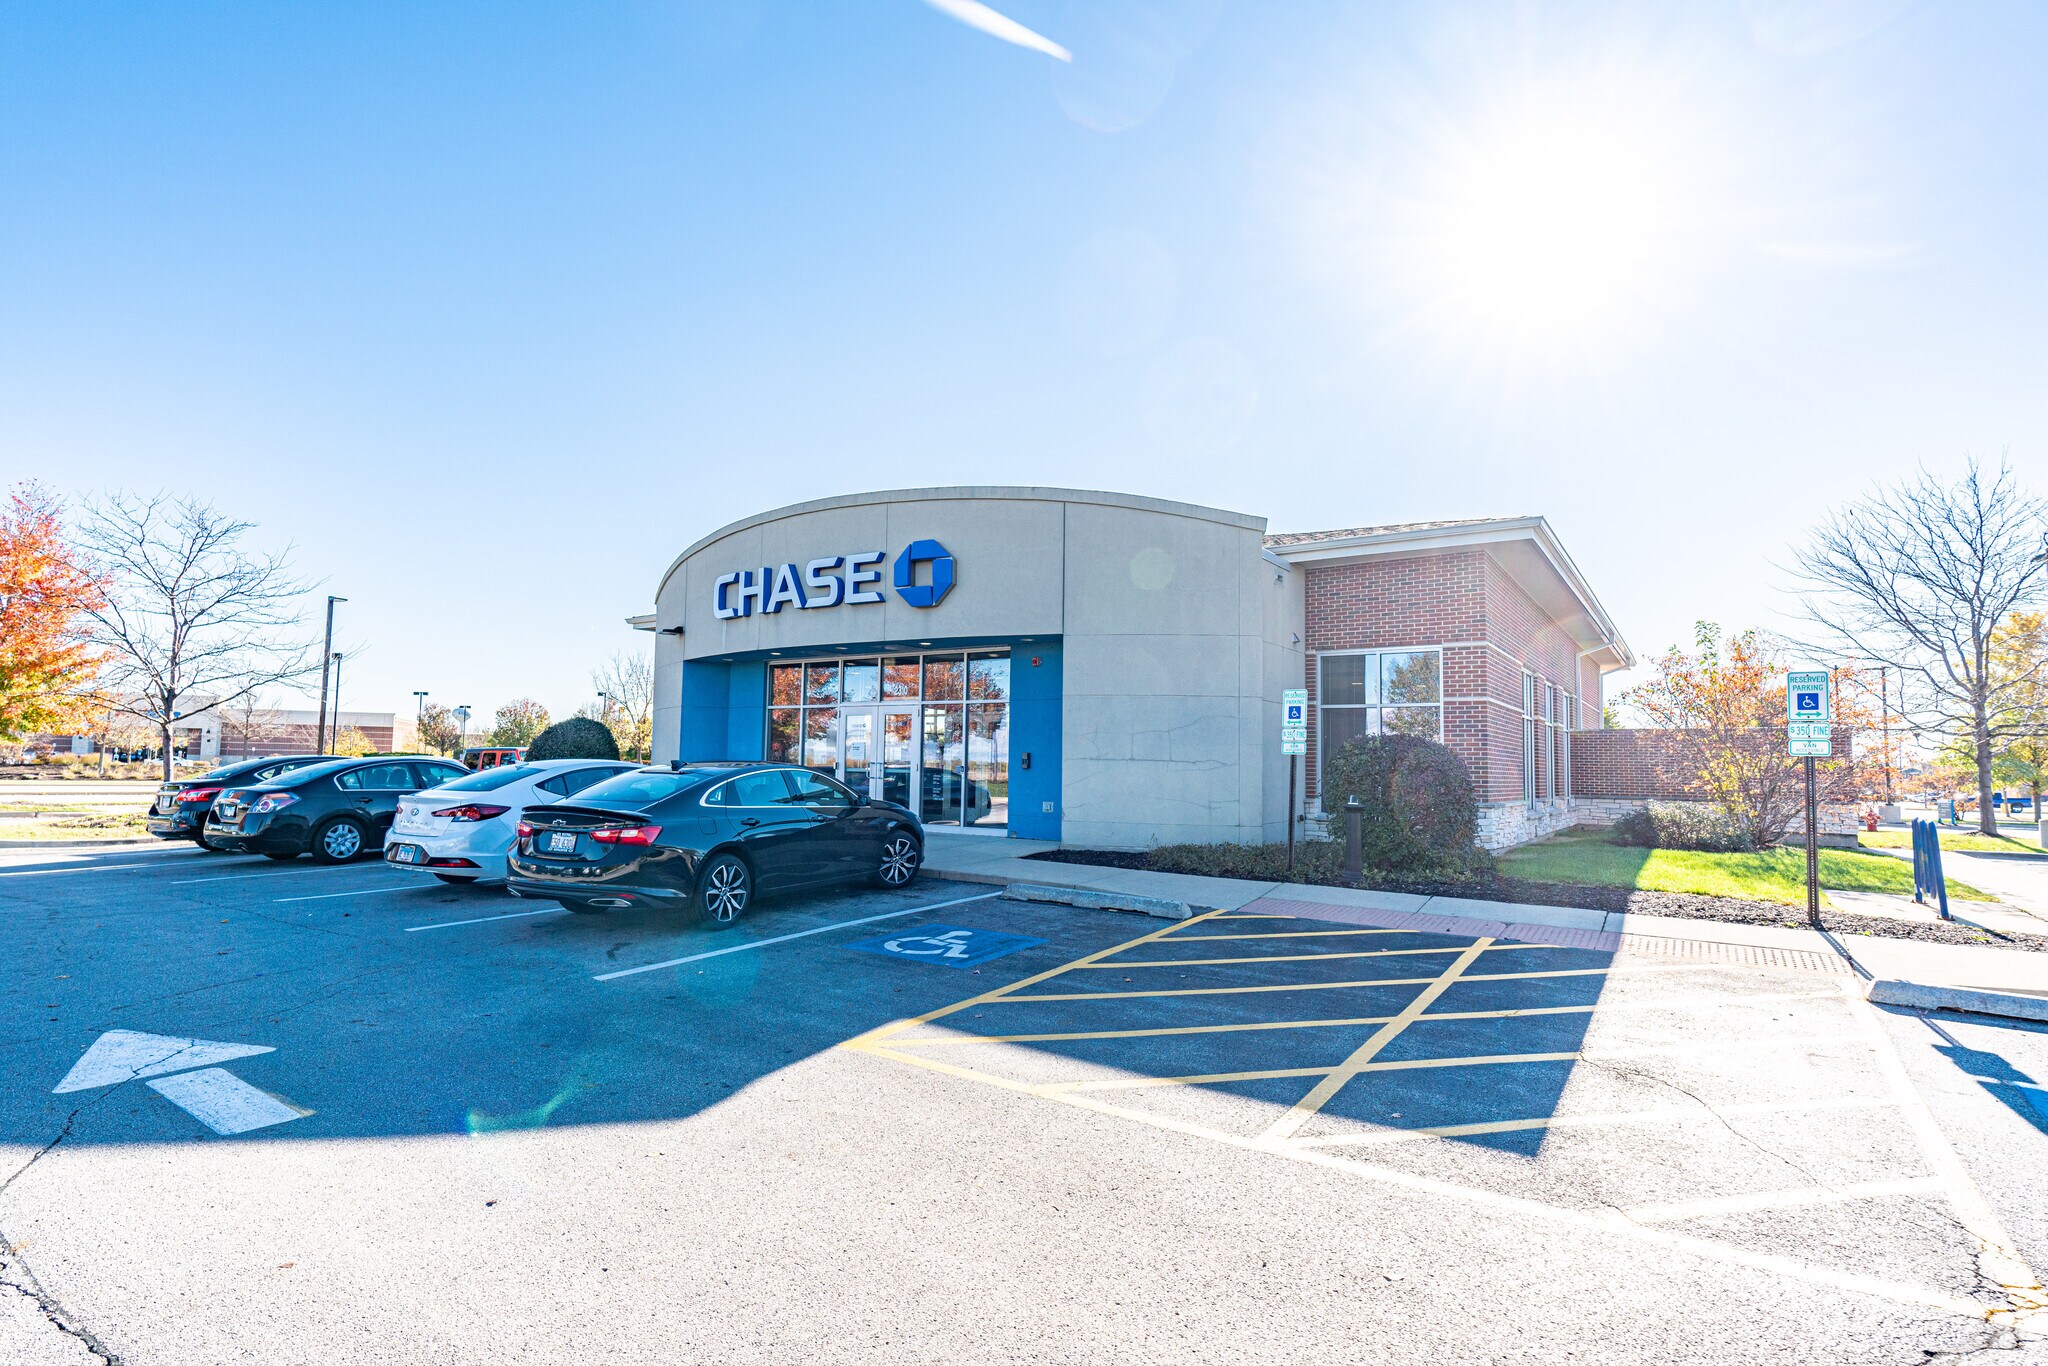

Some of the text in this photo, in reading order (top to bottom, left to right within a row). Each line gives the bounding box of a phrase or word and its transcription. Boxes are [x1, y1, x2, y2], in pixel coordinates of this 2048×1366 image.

[713, 551, 886, 620] CHASE
[1792, 684, 1824, 692] PARKING
[1813, 726, 1829, 736] FINE
